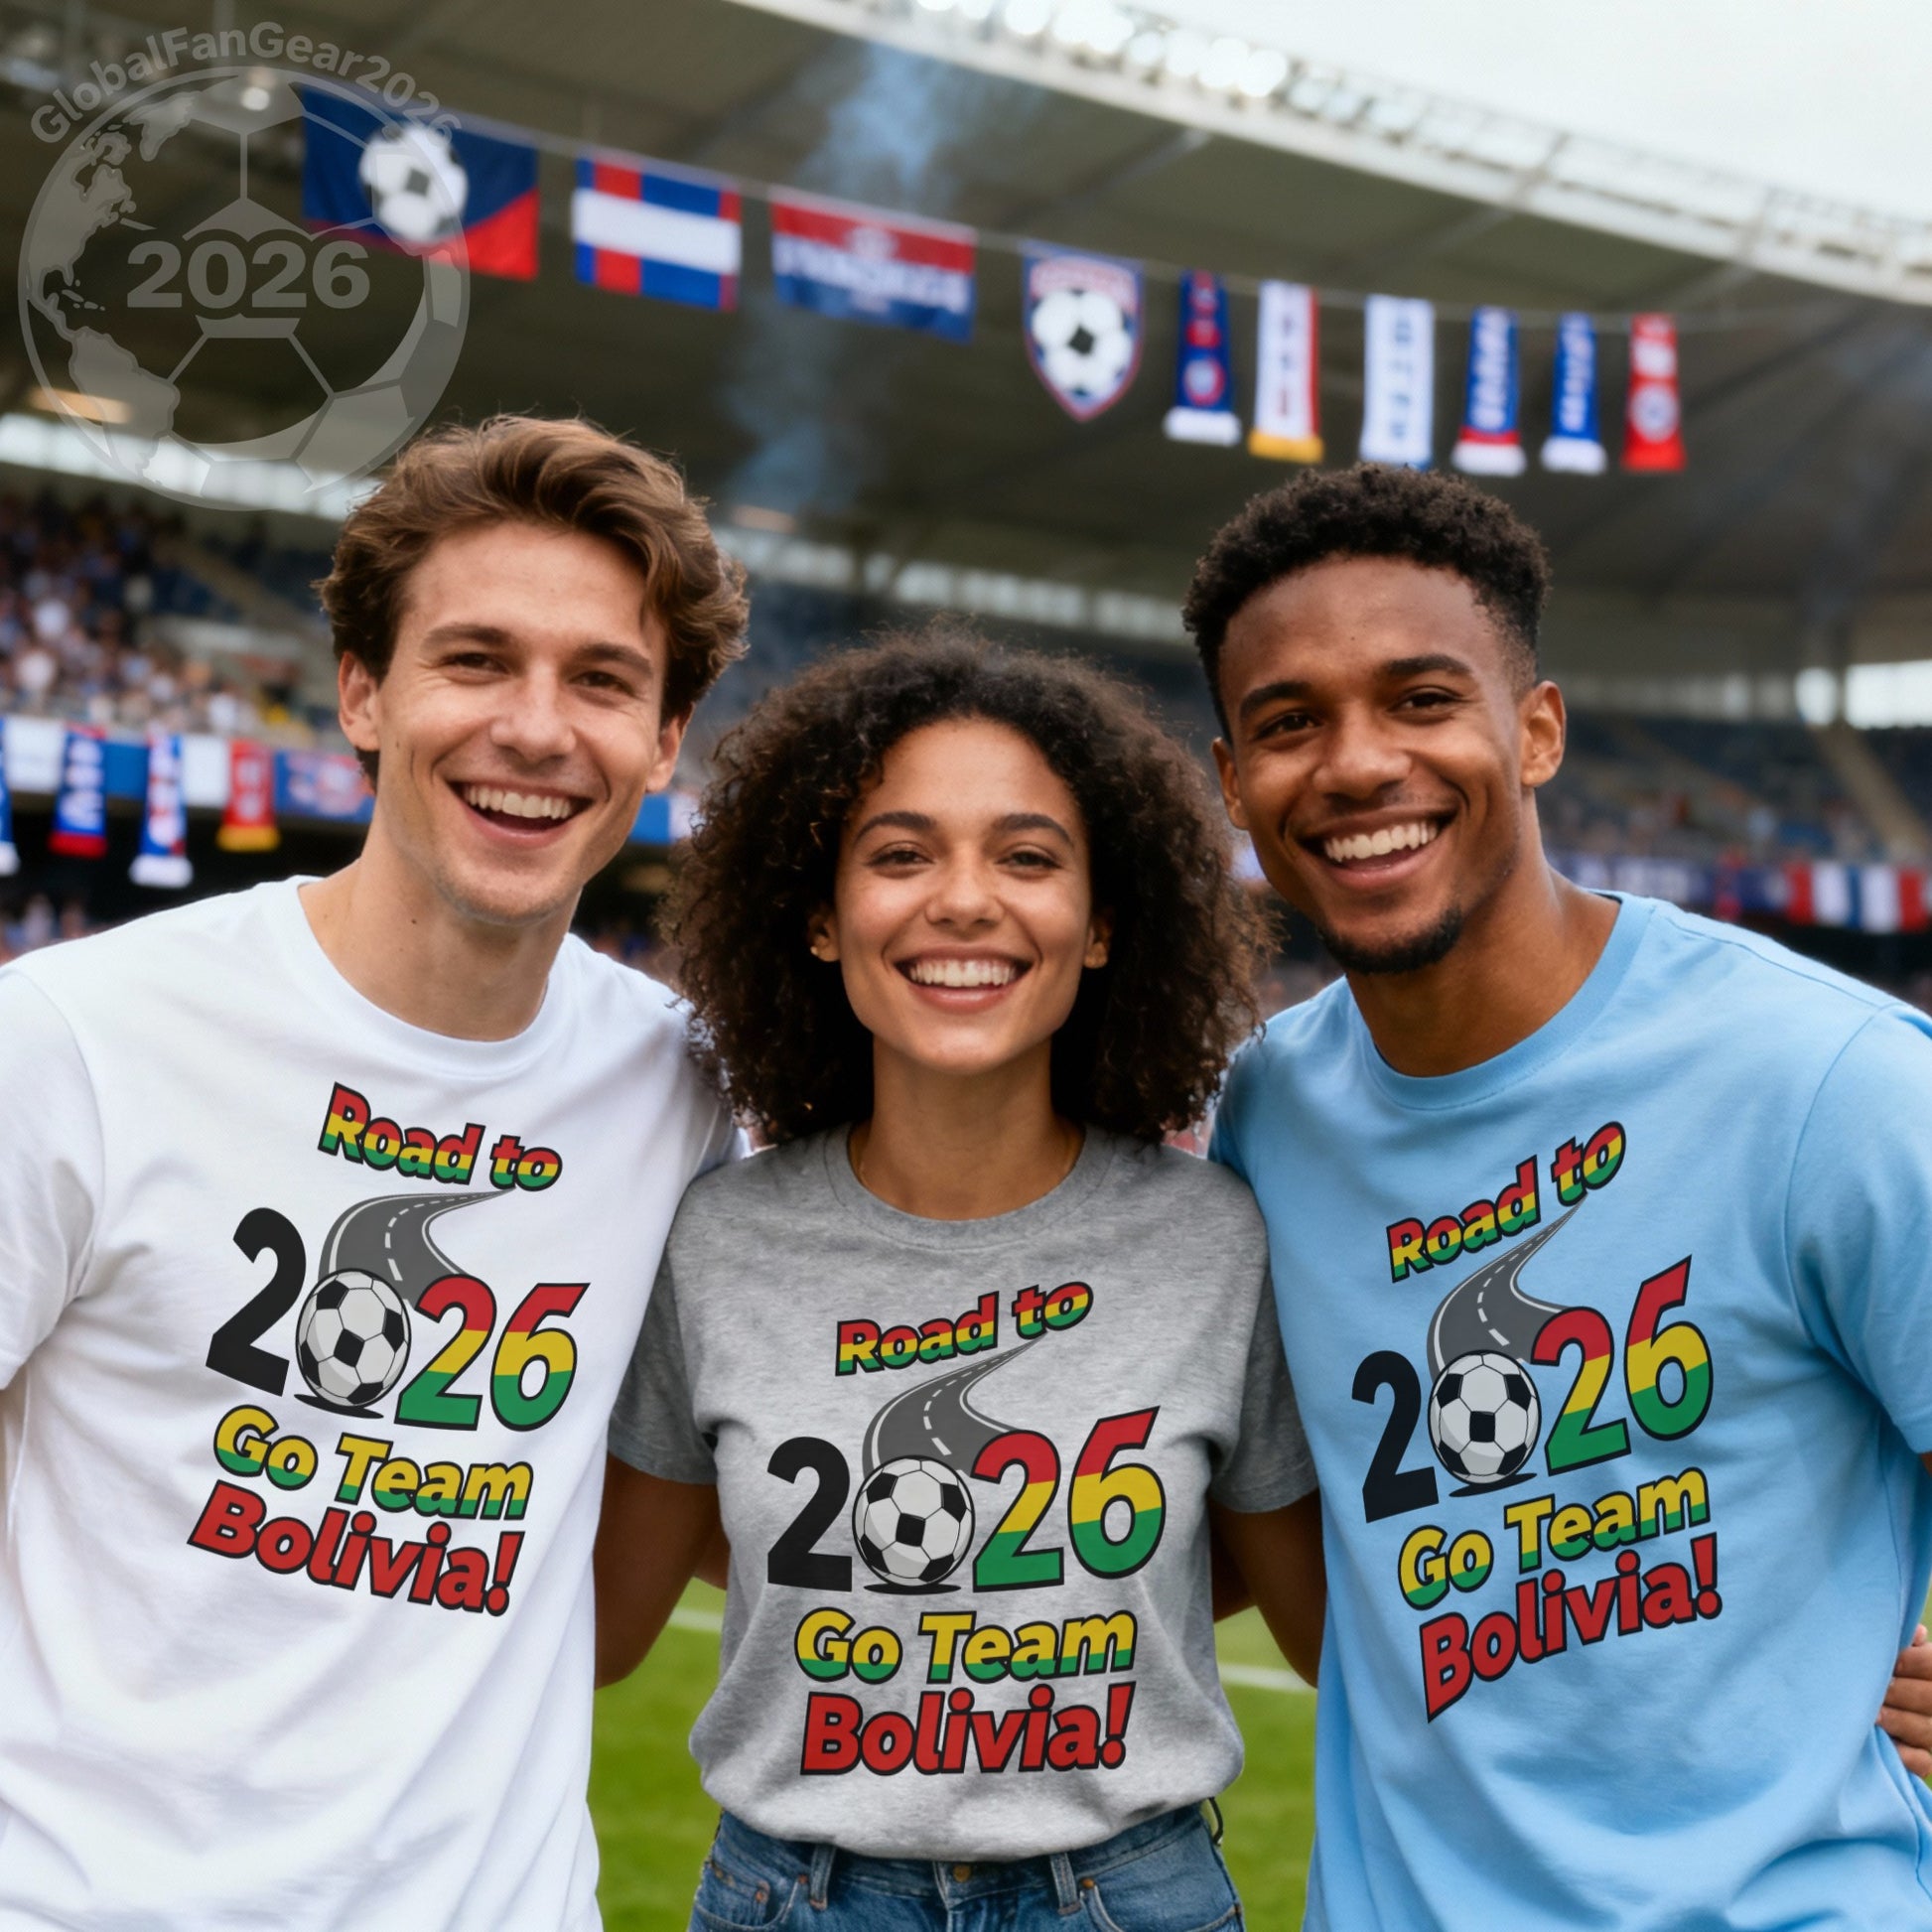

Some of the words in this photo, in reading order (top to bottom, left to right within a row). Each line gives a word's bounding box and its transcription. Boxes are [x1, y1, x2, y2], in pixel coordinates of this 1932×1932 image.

[317, 1081, 485, 1185] Road
[489, 1135, 563, 1191] to
[1386, 1155, 1541, 1283] Road
[1551, 1121, 1626, 1206] to
[835, 1292, 999, 1376] Road
[1012, 1282, 1094, 1339] to
[213, 1404, 319, 1491] Go
[335, 1433, 534, 1520] Team
[187, 1479, 525, 1617] Bolivia!
[1398, 1525, 1493, 1611] Go
[1504, 1466, 1711, 1575] Team
[794, 1607, 903, 1685] Go
[917, 1609, 1138, 1685] Team
[1420, 1532, 1723, 1724] Bolivia!
[800, 1681, 1137, 1775] Bolivia!
